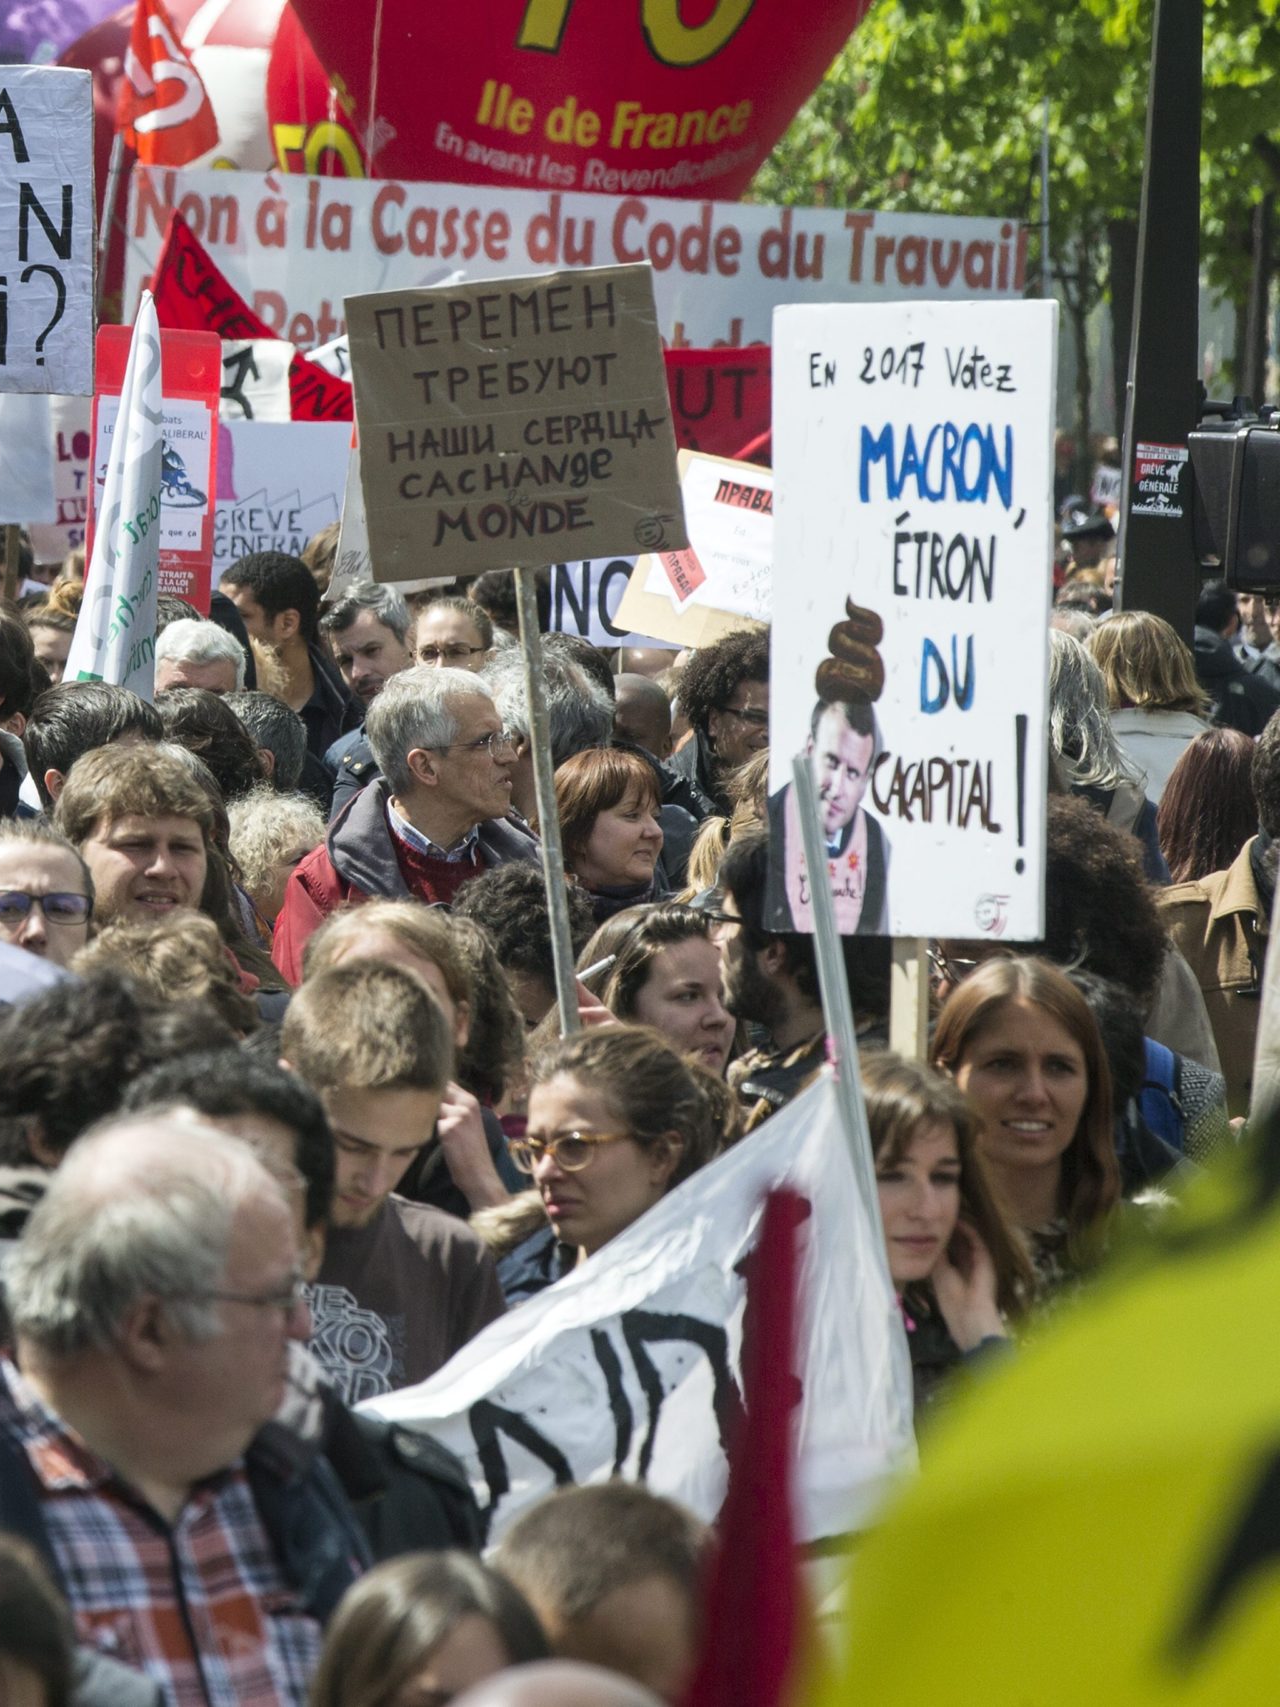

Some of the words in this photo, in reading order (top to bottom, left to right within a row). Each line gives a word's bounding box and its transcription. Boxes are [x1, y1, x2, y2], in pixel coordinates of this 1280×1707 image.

[477, 80, 534, 135] Ile
[545, 96, 601, 147] de
[610, 100, 752, 149] France
[435, 122, 462, 156] En
[467, 141, 535, 180] avant
[538, 154, 576, 186] les
[135, 172, 239, 245] Non
[256, 176, 289, 248] à
[306, 180, 353, 251] la
[371, 184, 512, 261] Casse
[525, 193, 595, 265] du
[612, 197, 742, 278] Code
[758, 206, 825, 280] du
[844, 212, 1030, 292] Travail
[375, 282, 616, 350] ПЕРЕМЕН
[414, 353, 617, 404] ТРЕБУЮТ
[859, 342, 925, 388] 2017
[945, 345, 1017, 393] Votez
[388, 425, 495, 464] НАШИ
[523, 408, 666, 448] СЕРДЦА
[215, 508, 303, 534] GREVE
[433, 495, 594, 548] MONDE
[893, 511, 996, 603] ÉTRON
[920, 634, 975, 714] DU
